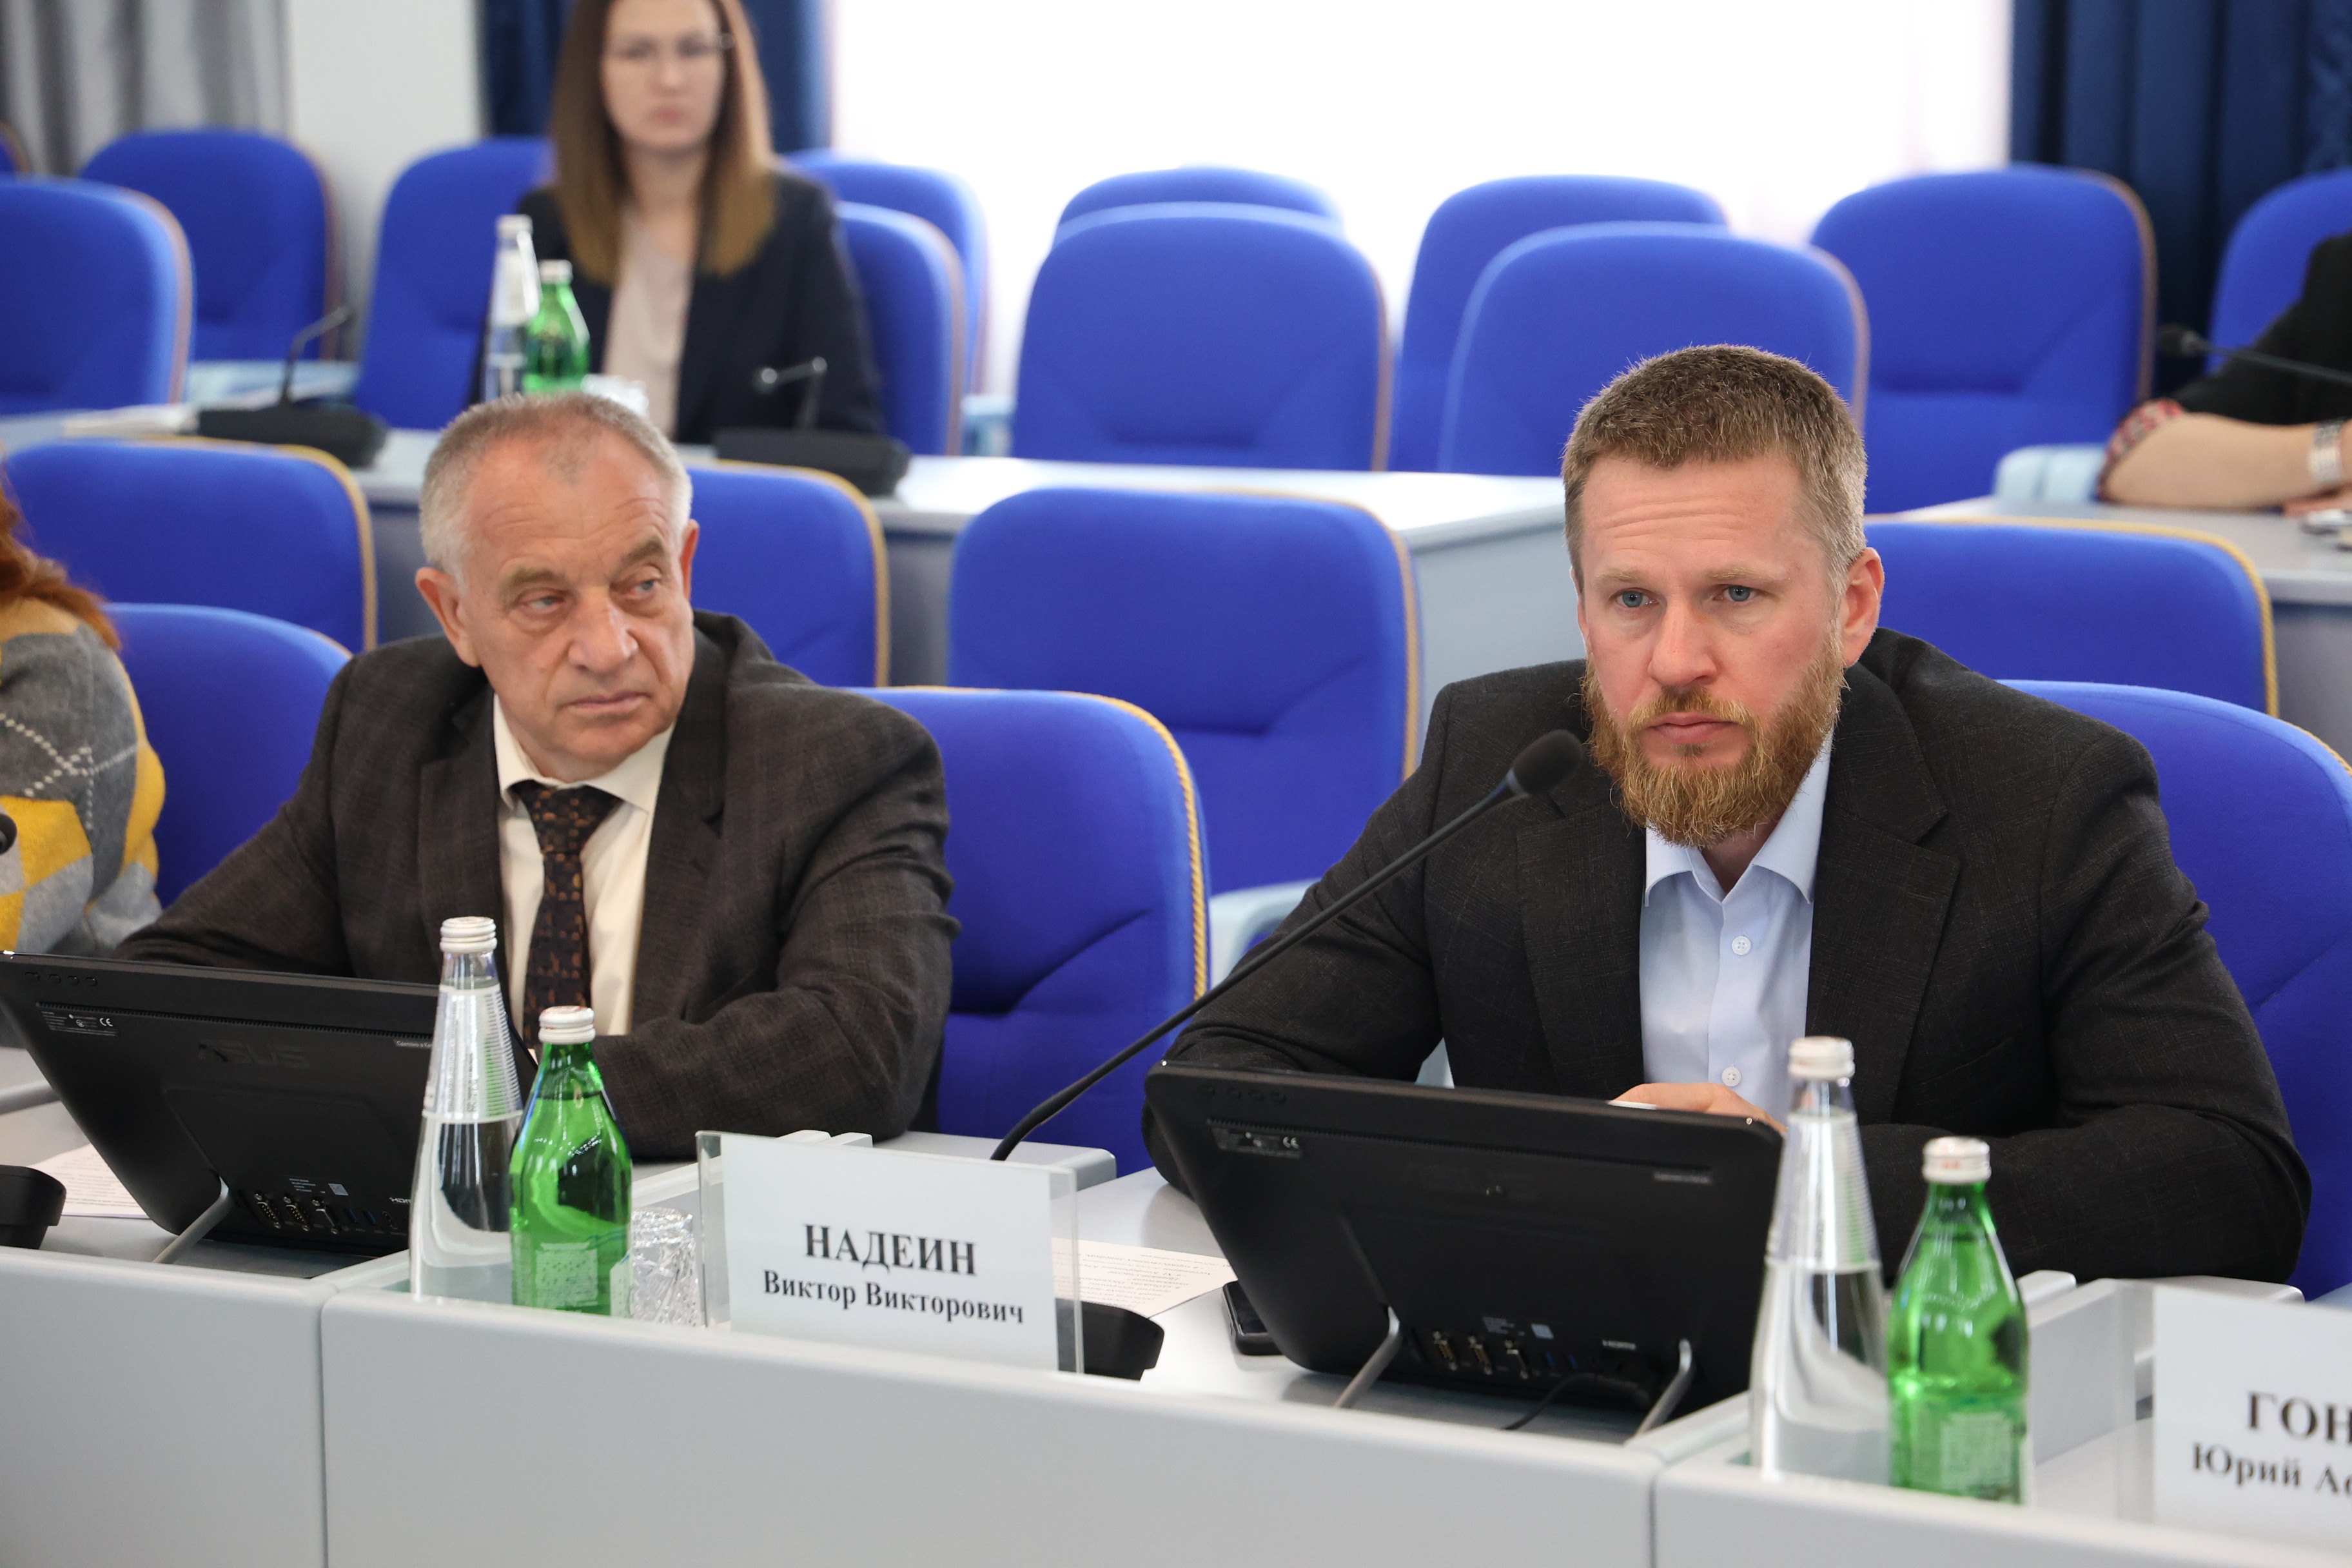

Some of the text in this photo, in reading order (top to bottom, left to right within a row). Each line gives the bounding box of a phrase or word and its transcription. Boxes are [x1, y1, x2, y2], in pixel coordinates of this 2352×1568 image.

[803, 1224, 977, 1276] НАДЕИН
[763, 1269, 1024, 1324] Виктор Викторович
[2247, 1391, 2352, 1446] ГОН
[2192, 1442, 2302, 1487] Юрий
